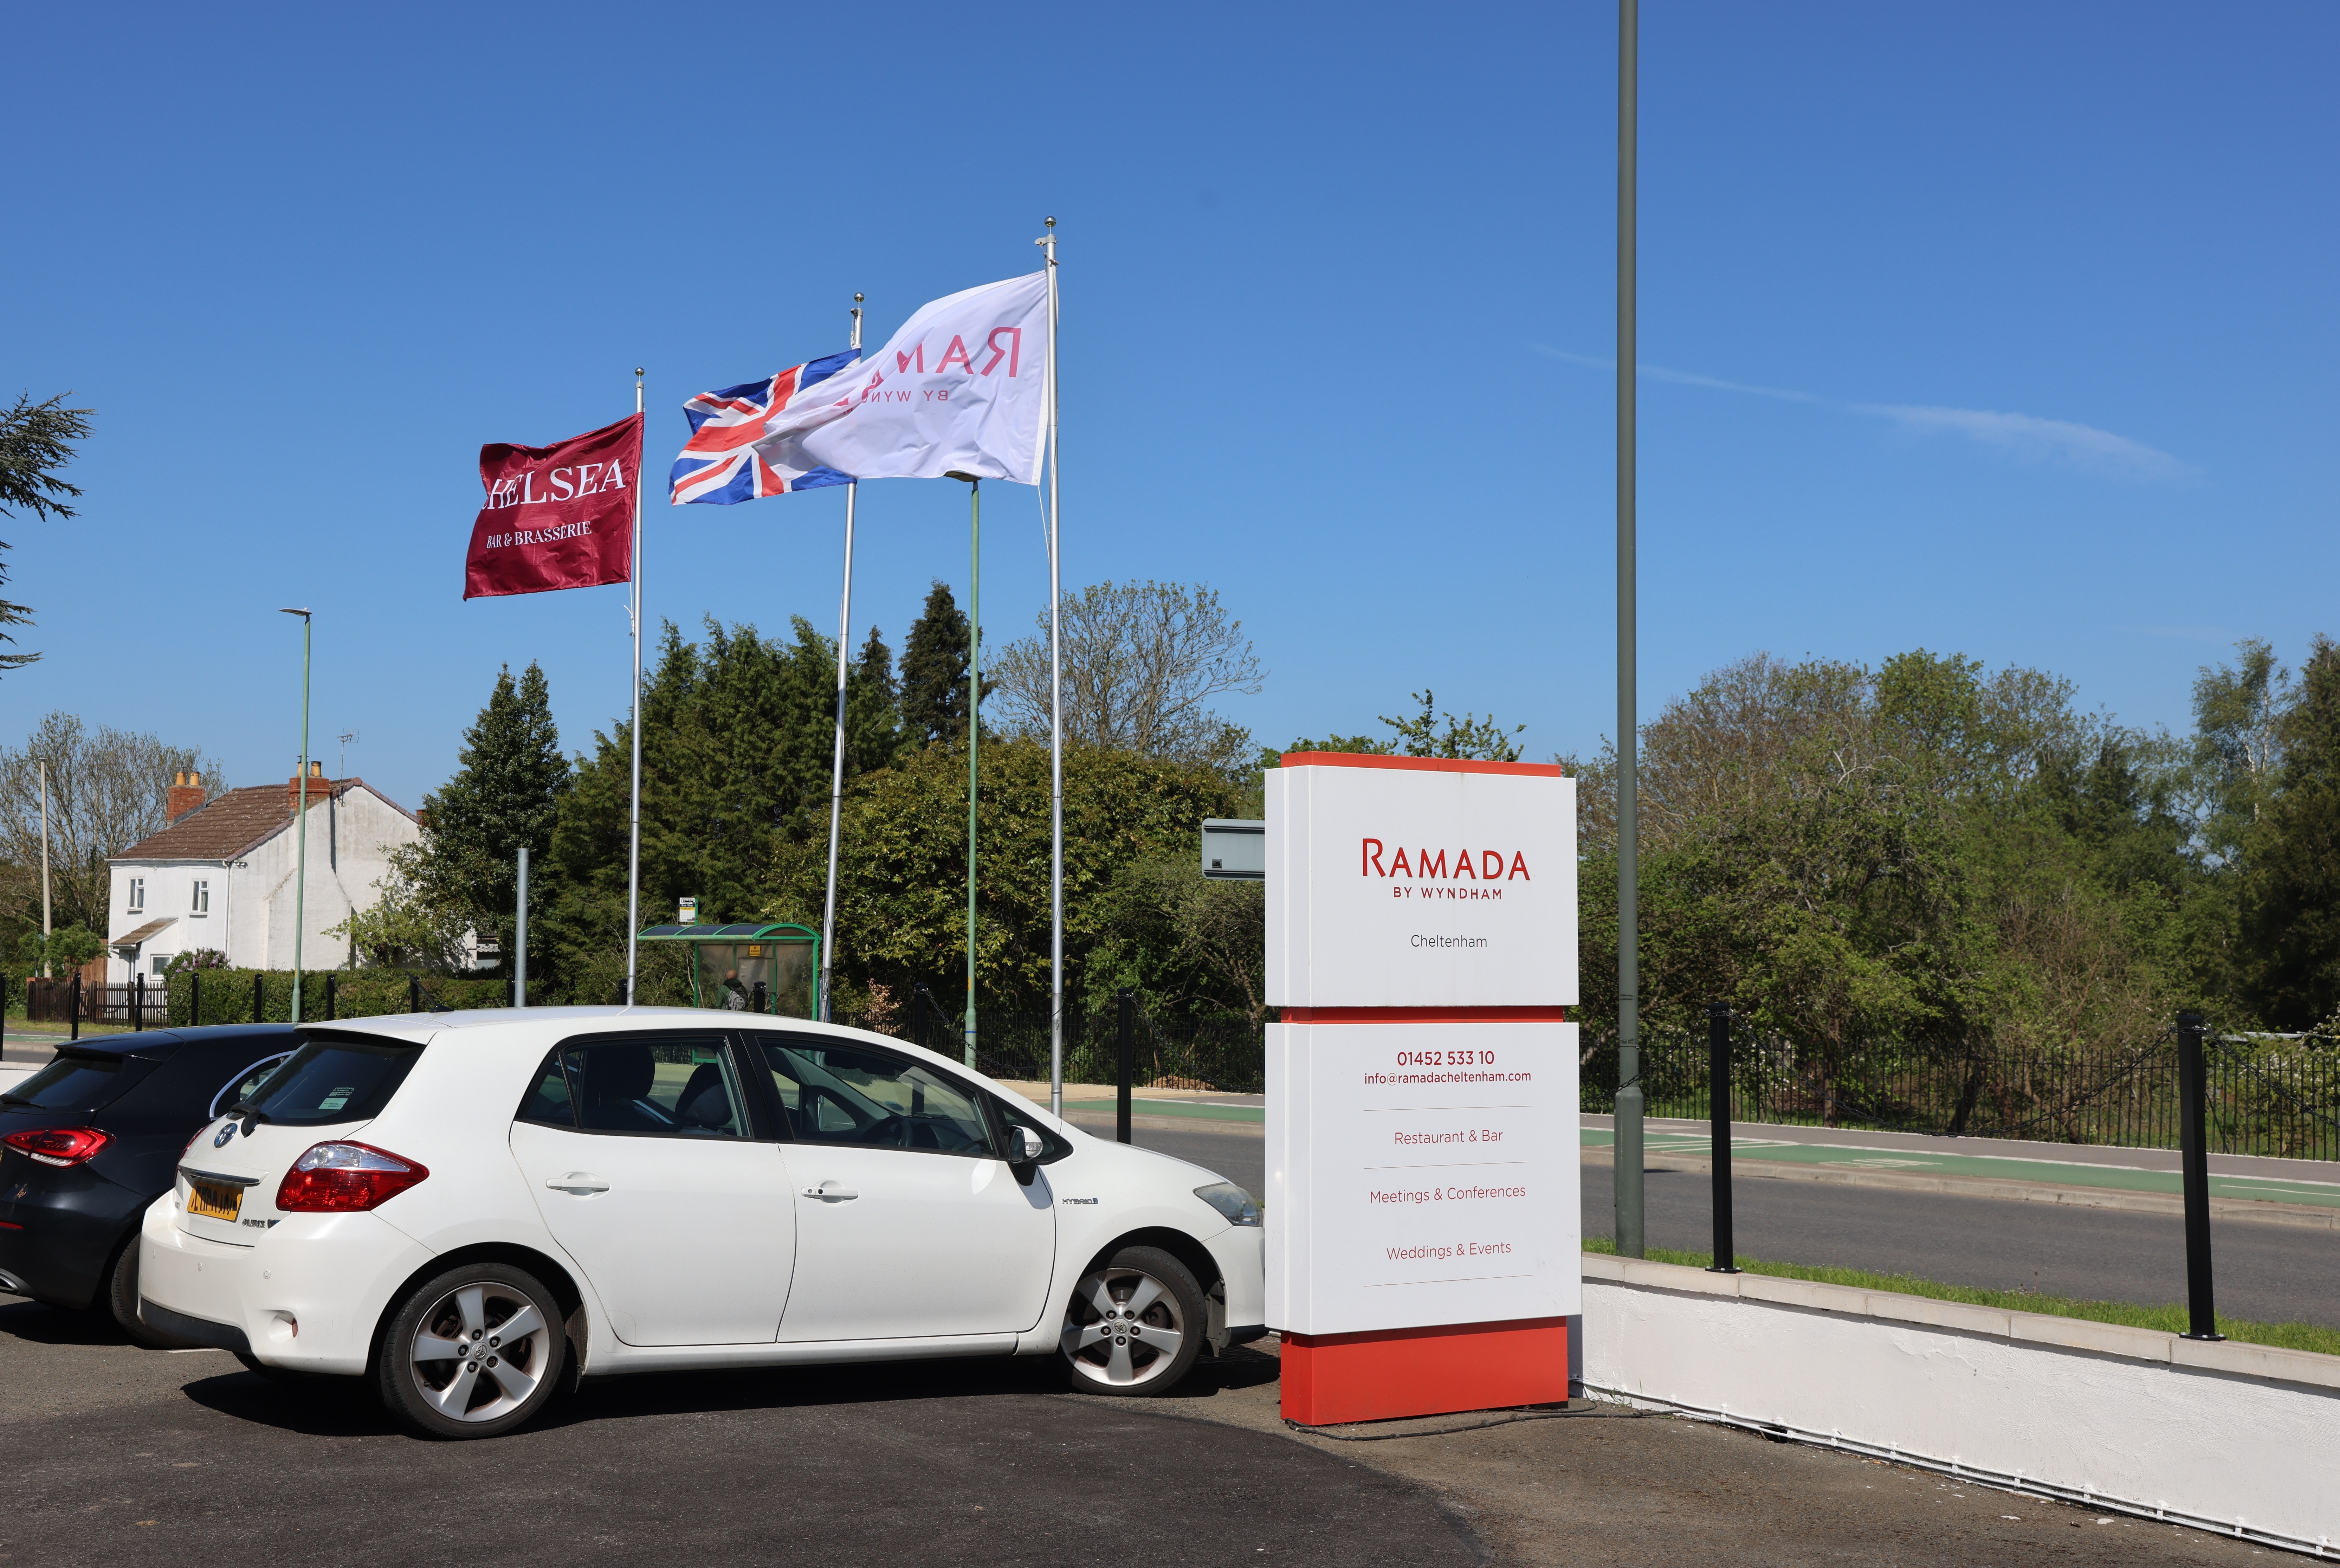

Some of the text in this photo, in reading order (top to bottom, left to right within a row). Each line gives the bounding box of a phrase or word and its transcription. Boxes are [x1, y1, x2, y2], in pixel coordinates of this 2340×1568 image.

[482, 459, 626, 510] HELSEA
[486, 521, 592, 549] BAR & BRASSERIE
[1362, 838, 1530, 880] RAMADA
[1394, 887, 1502, 899] BY WYNDHAM
[1411, 934, 1487, 948] Cheltenham
[1397, 1050, 1495, 1066] 01452 533 10
[1364, 1071, 1531, 1085] info@ramadacheltenham.com
[1395, 1129, 1503, 1145] Restaurant & Bar
[1370, 1186, 1526, 1204] Meetings & Conferences
[242, 1219, 266, 1228] AURIS
[1387, 1242, 1511, 1260] Weddings & Events
